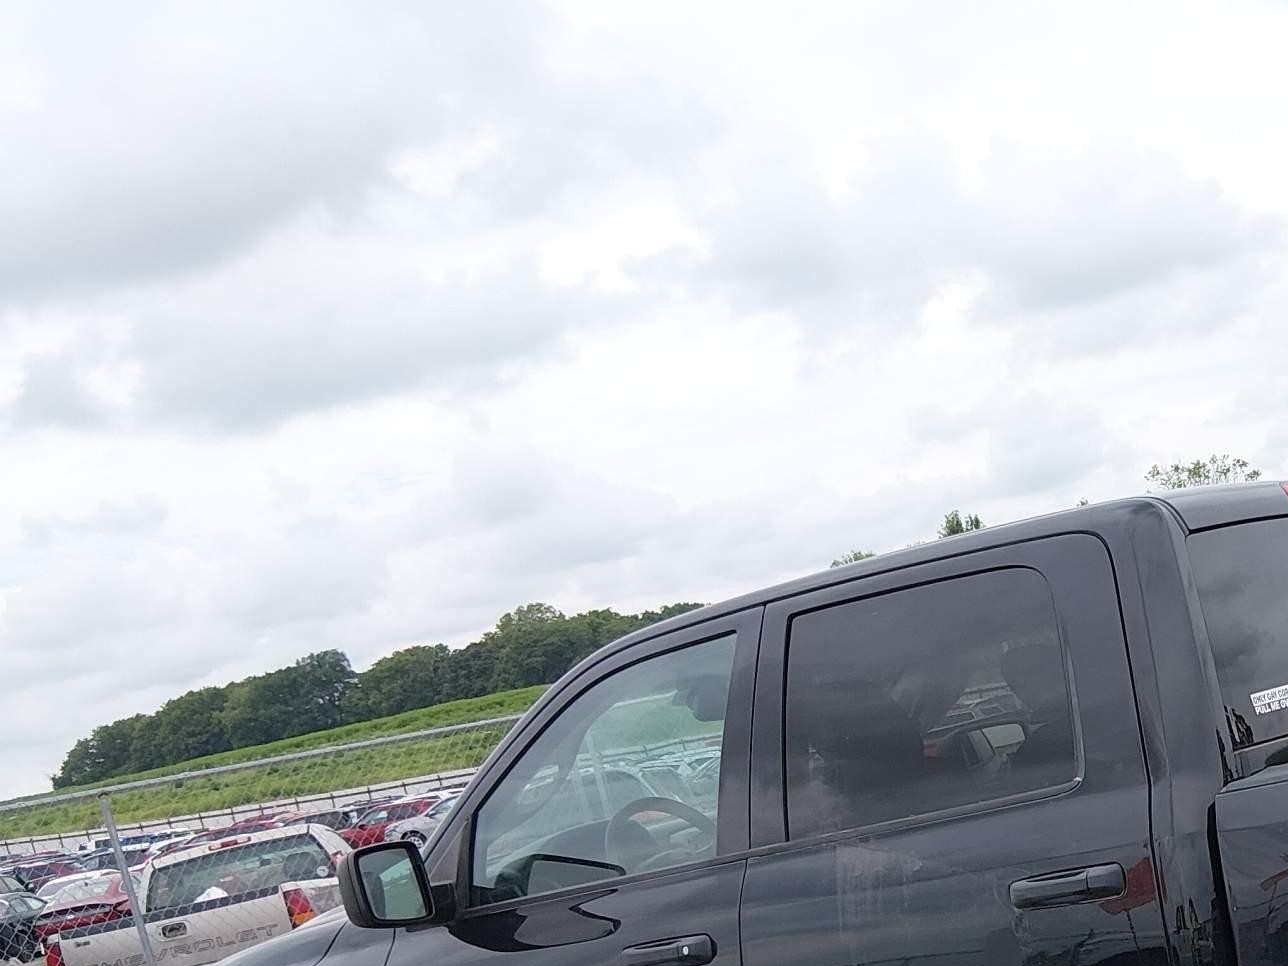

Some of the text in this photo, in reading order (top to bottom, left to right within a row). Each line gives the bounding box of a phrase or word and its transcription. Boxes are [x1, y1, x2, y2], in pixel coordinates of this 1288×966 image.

[1253, 694, 1265, 705] ONLY
[1266, 691, 1277, 701] GAY
[1255, 703, 1271, 715] PULL
[1271, 701, 1280, 711] ME
